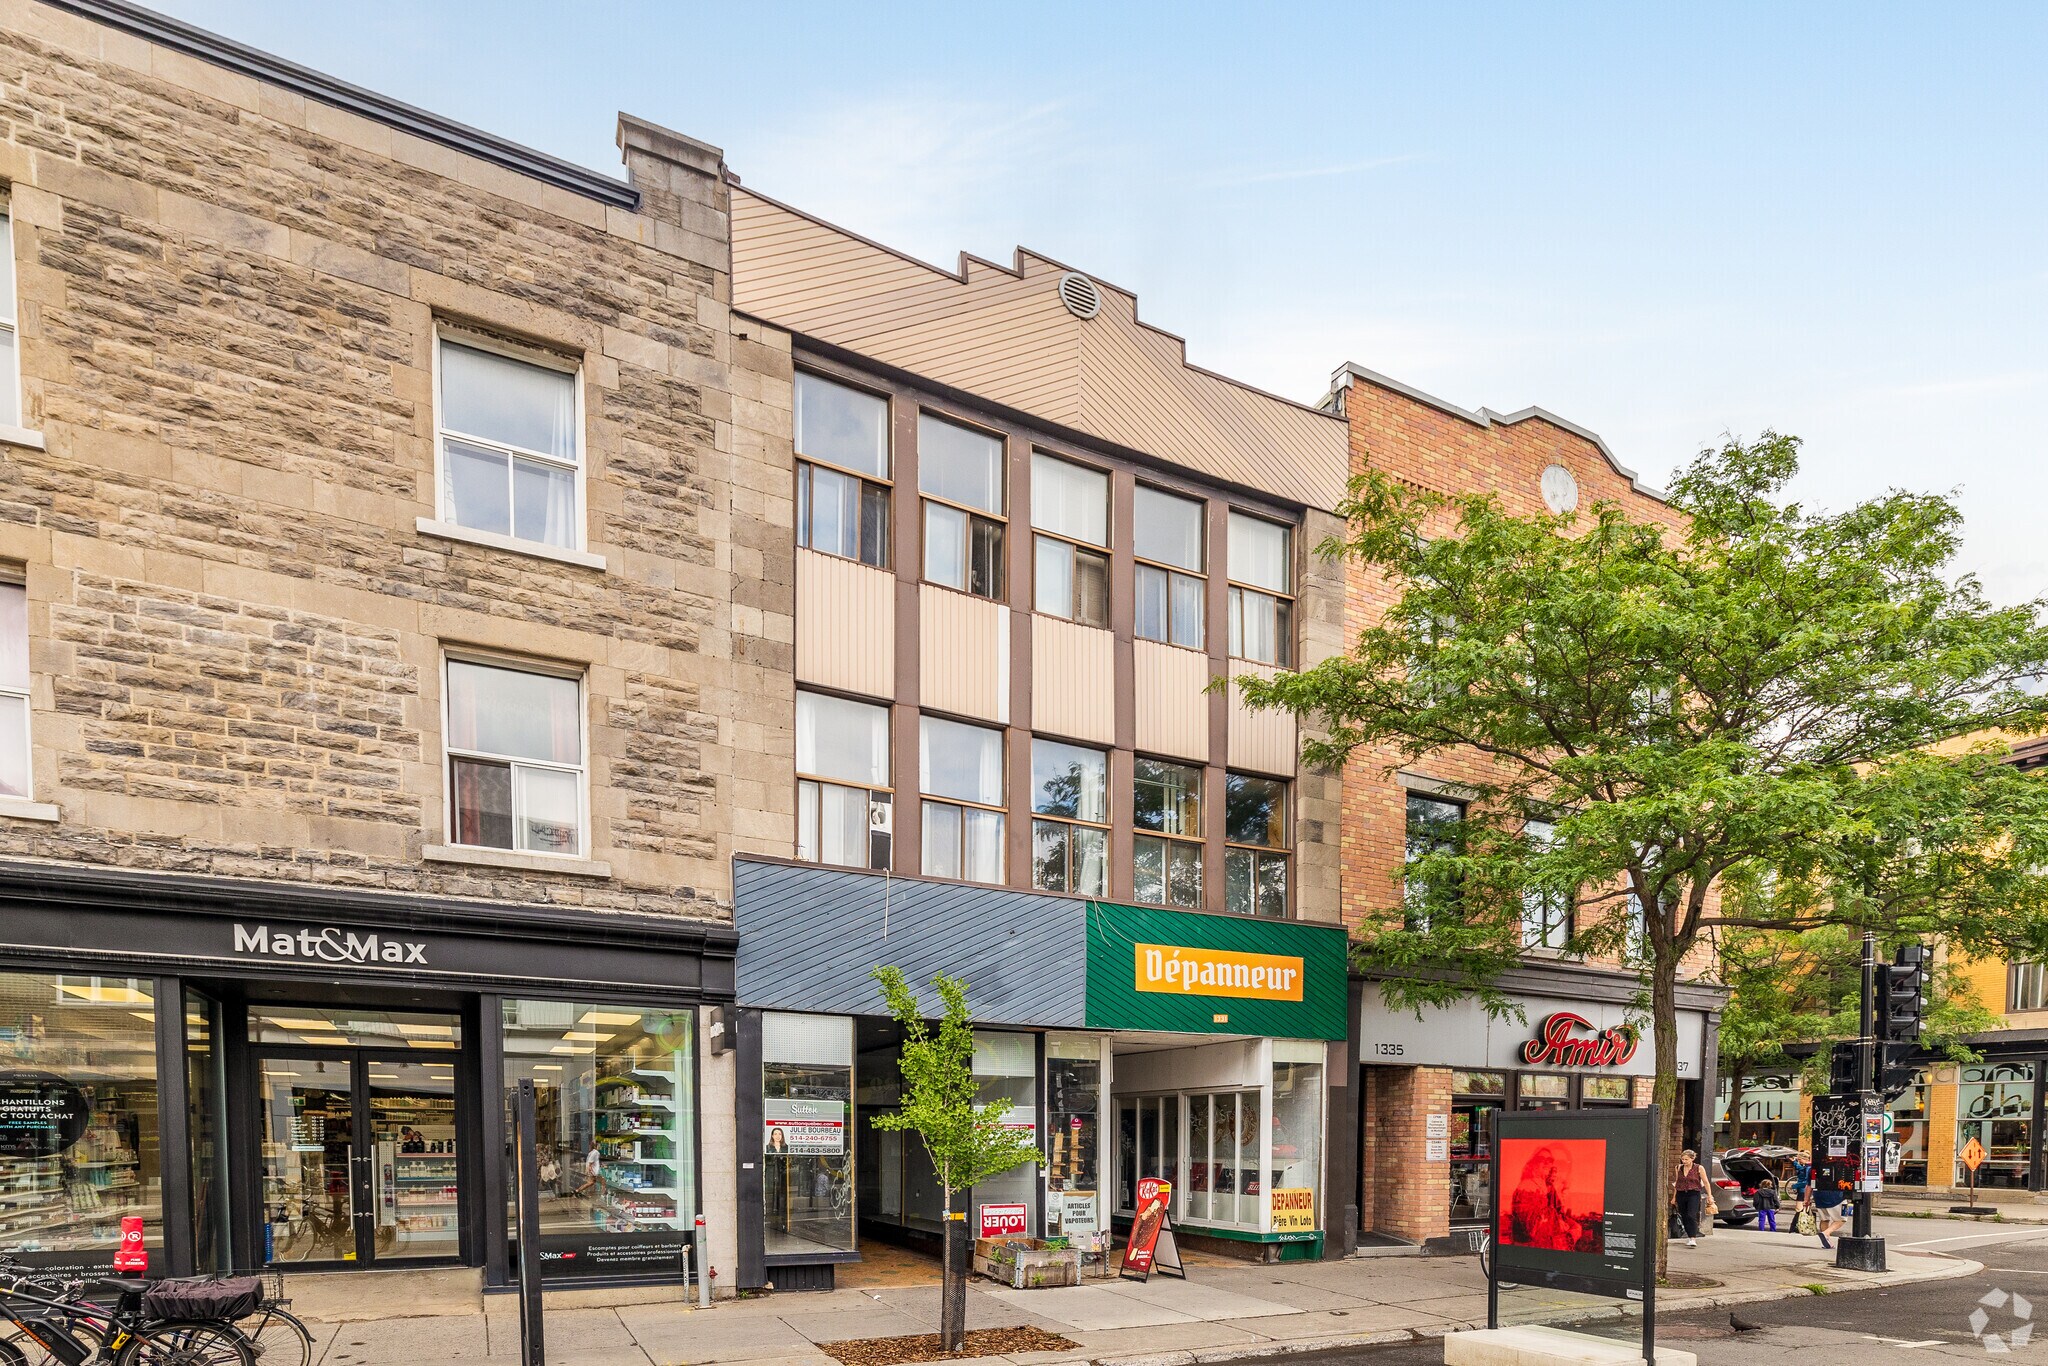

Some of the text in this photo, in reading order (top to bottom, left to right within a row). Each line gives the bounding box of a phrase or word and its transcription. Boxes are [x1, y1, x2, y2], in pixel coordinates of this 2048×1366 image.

[233, 923, 428, 965] Mat&Max
[1145, 949, 1297, 992] Dépanneur
[1520, 1011, 1639, 1067] Amir
[1374, 1043, 1404, 1056] 1335
[1272, 1192, 1312, 1210] DEPANNEUR
[984, 1216, 1024, 1228] LOUER
[1289, 1215, 1298, 1226] Vin
[1300, 1216, 1312, 1226] Loto
